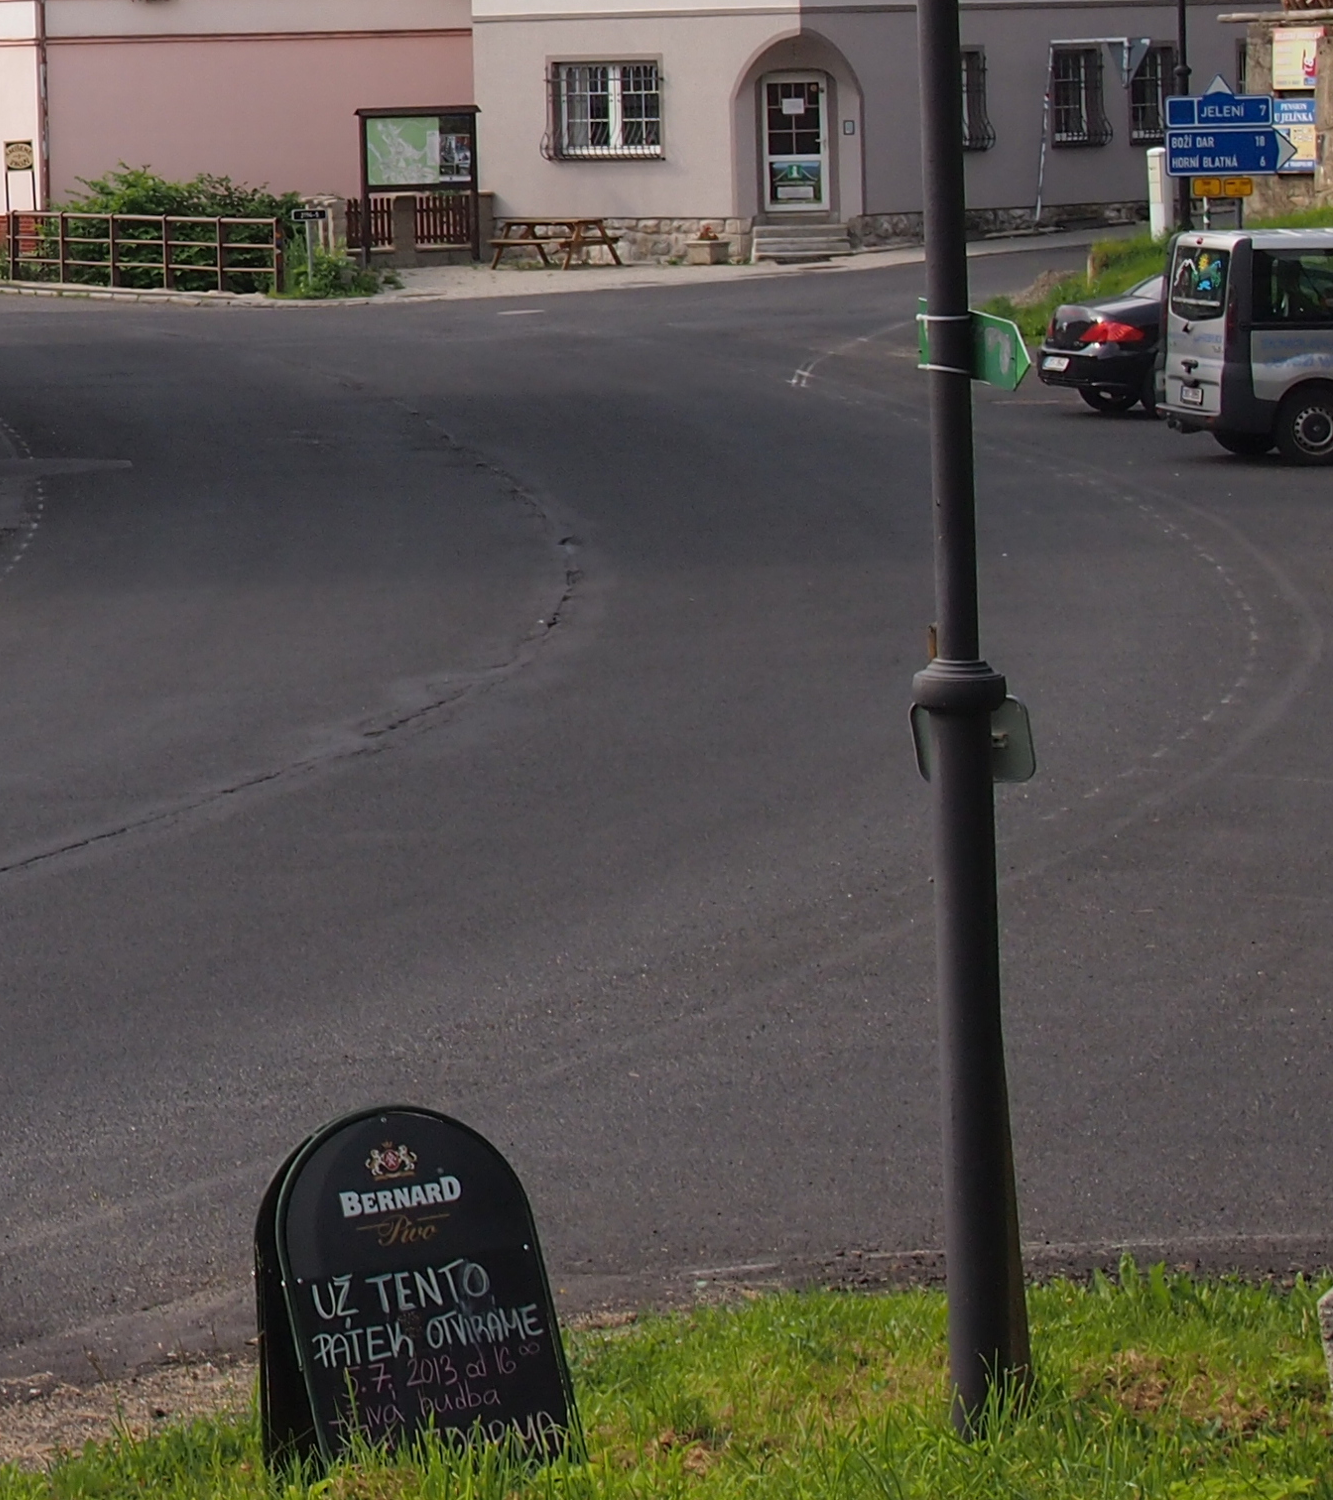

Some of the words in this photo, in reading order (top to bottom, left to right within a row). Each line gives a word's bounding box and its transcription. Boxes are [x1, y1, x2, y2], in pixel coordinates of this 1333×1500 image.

[1201, 103, 1244, 118] JELENÍ
[1259, 105, 1267, 117] 7
[1171, 135, 1192, 149] BOŽÍ
[1196, 137, 1215, 148] DAR
[1255, 135, 1266, 147] 18
[1172, 155, 1199, 169] HORNÍ
[1203, 154, 1238, 168] BLATNÁ
[1259, 156, 1266, 167] 6
[339, 1175, 462, 1218] BERNARD
[377, 1214, 438, 1247] Pivo
[312, 1274, 360, 1320] UŽ
[366, 1259, 490, 1315] TENTO
[406, 1354, 459, 1388] 2013
[465, 1342, 488, 1379] od
[418, 1380, 501, 1418] hudba
